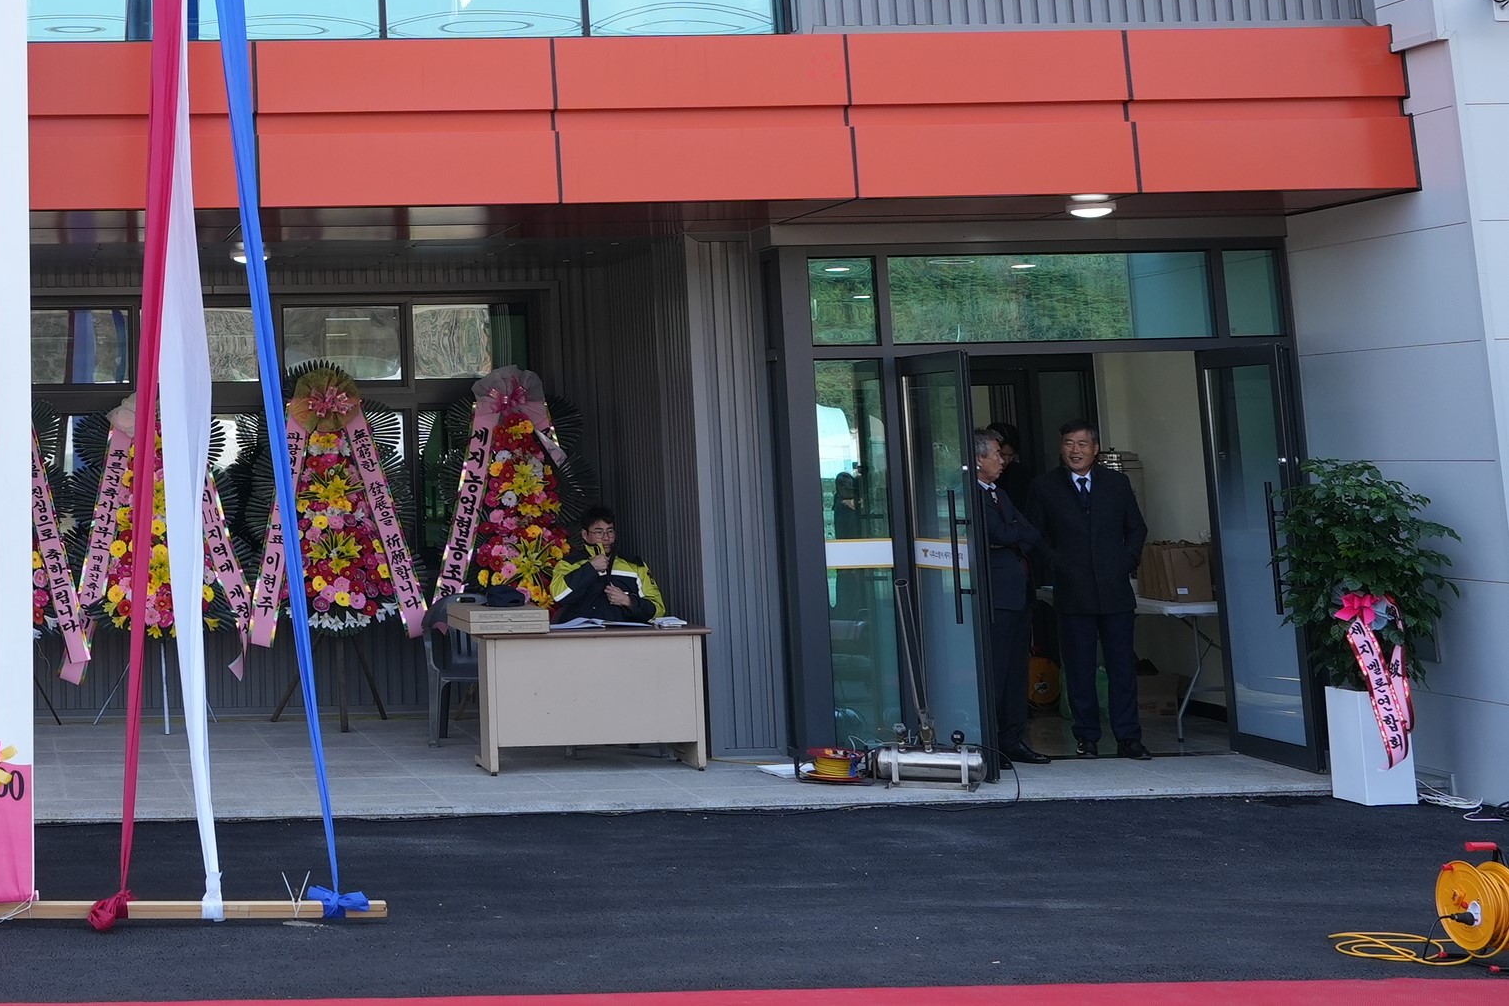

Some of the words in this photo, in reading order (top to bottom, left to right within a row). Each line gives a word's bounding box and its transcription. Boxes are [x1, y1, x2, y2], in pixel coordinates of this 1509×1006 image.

[91, 449, 128, 552] 푸른건축사사무소
[44, 548, 80, 633] 축하드립니다
[1350, 621, 1403, 752] 세지멜론연합회
